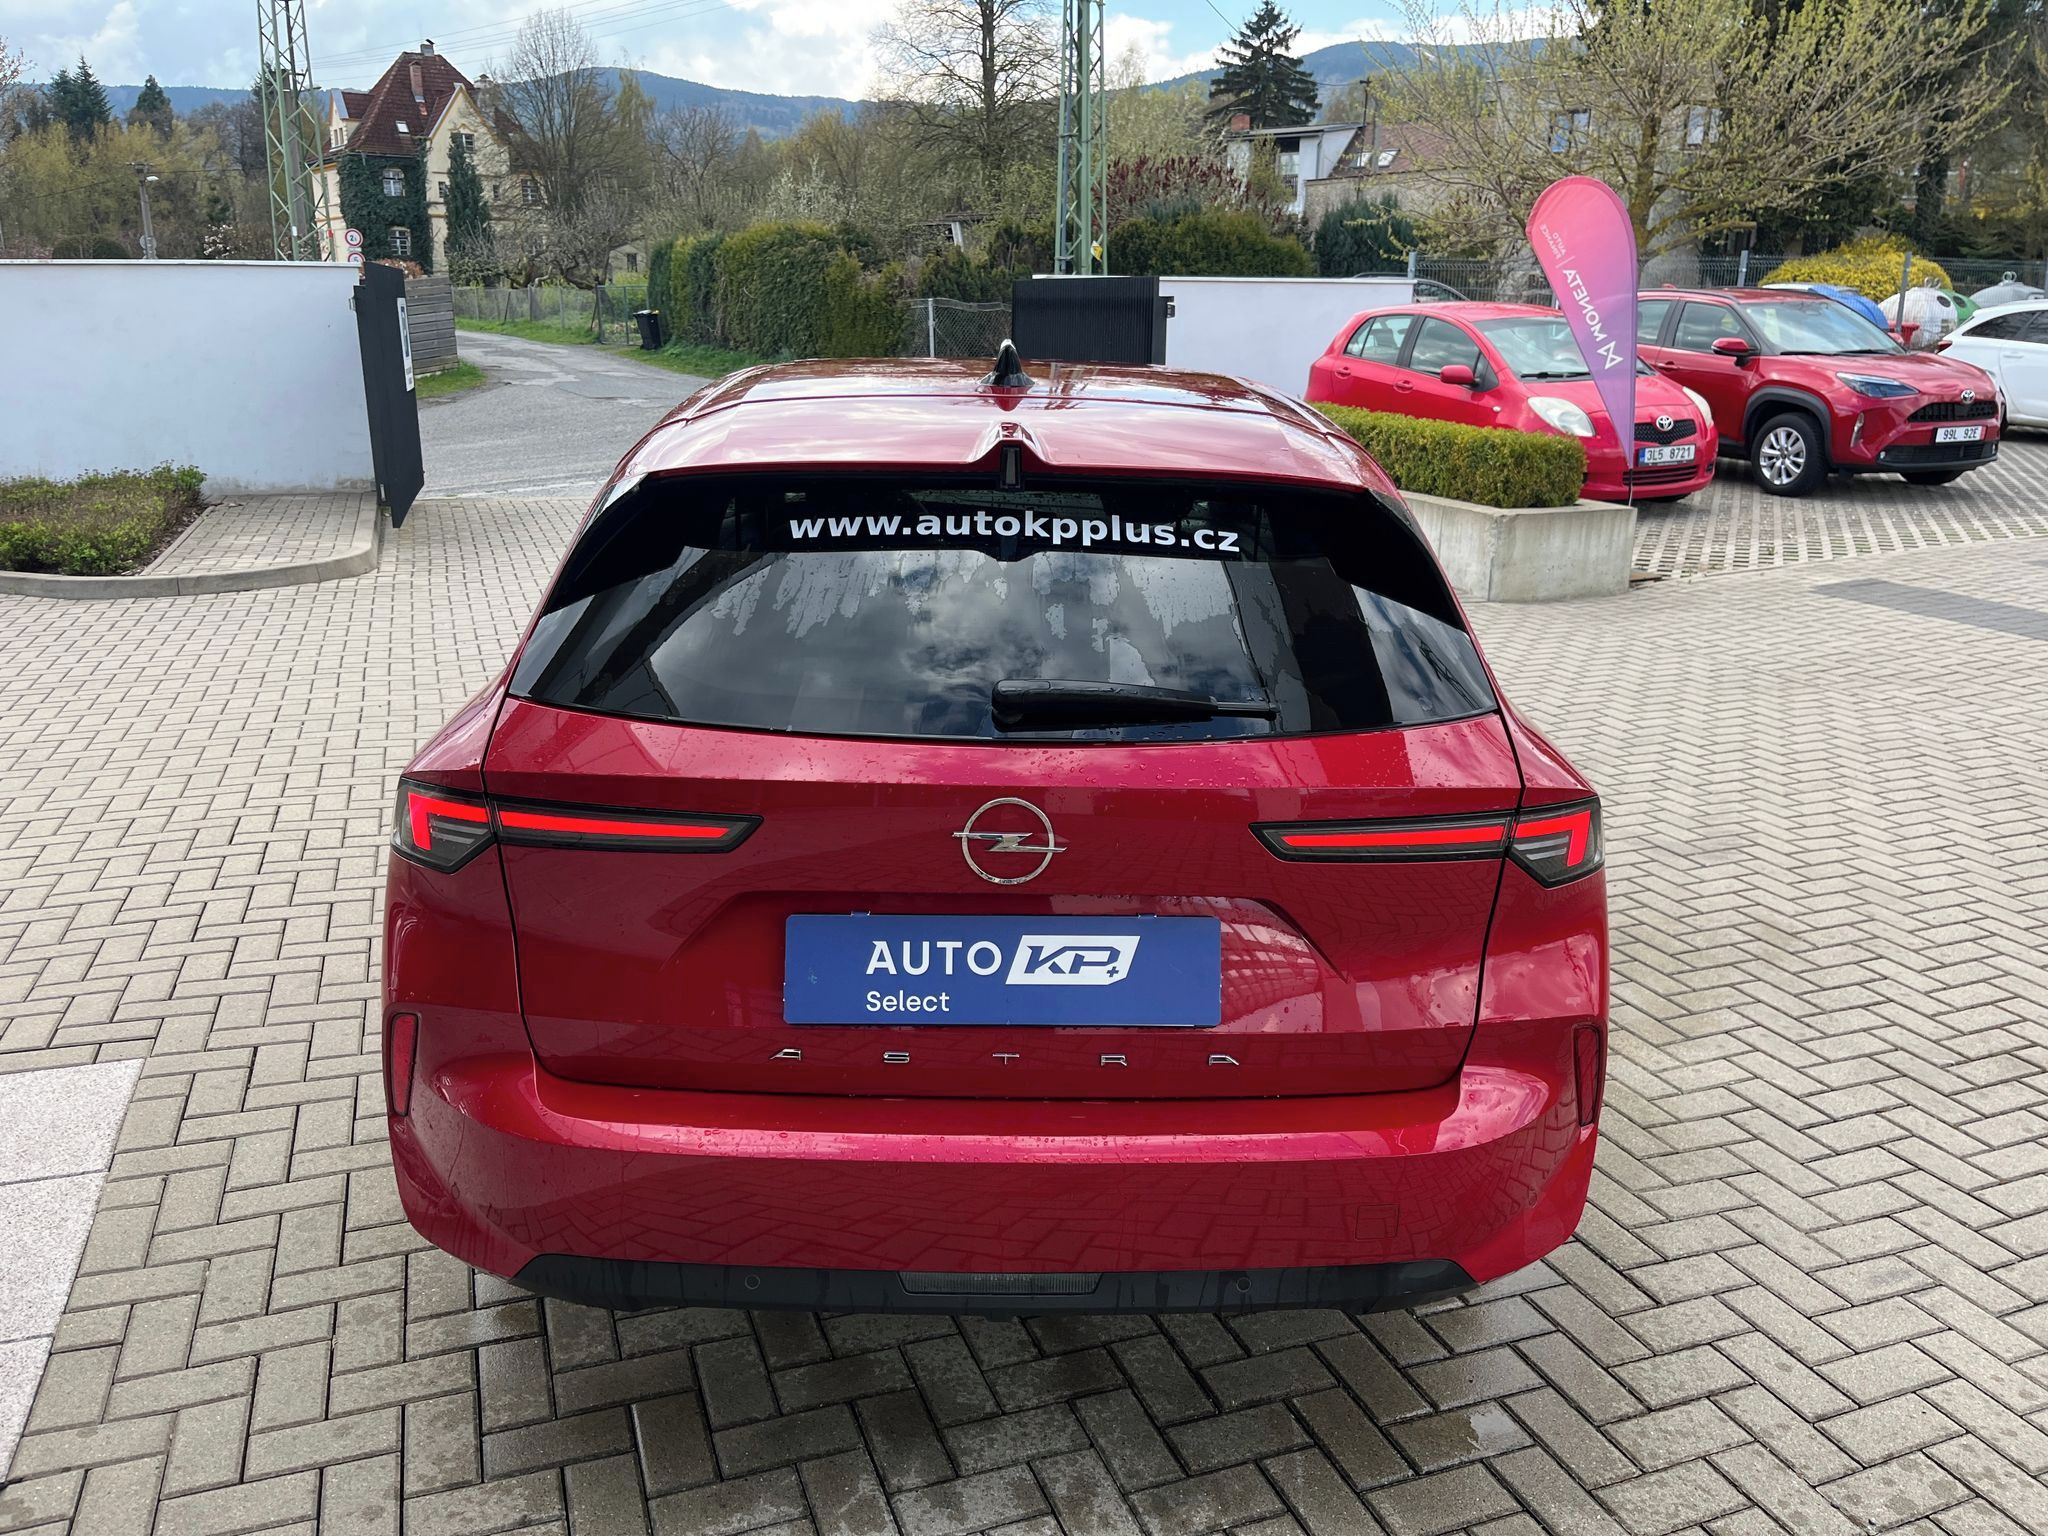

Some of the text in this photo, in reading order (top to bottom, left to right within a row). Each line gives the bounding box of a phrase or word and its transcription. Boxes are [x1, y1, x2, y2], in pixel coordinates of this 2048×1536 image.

[1646, 446, 1691, 461] 3L5 8721
[789, 510, 1240, 552] www.autokpplus.cz
[866, 940, 1002, 976] AUTO
[866, 990, 950, 1012] Select
[769, 1048, 1239, 1066] ASTRA
